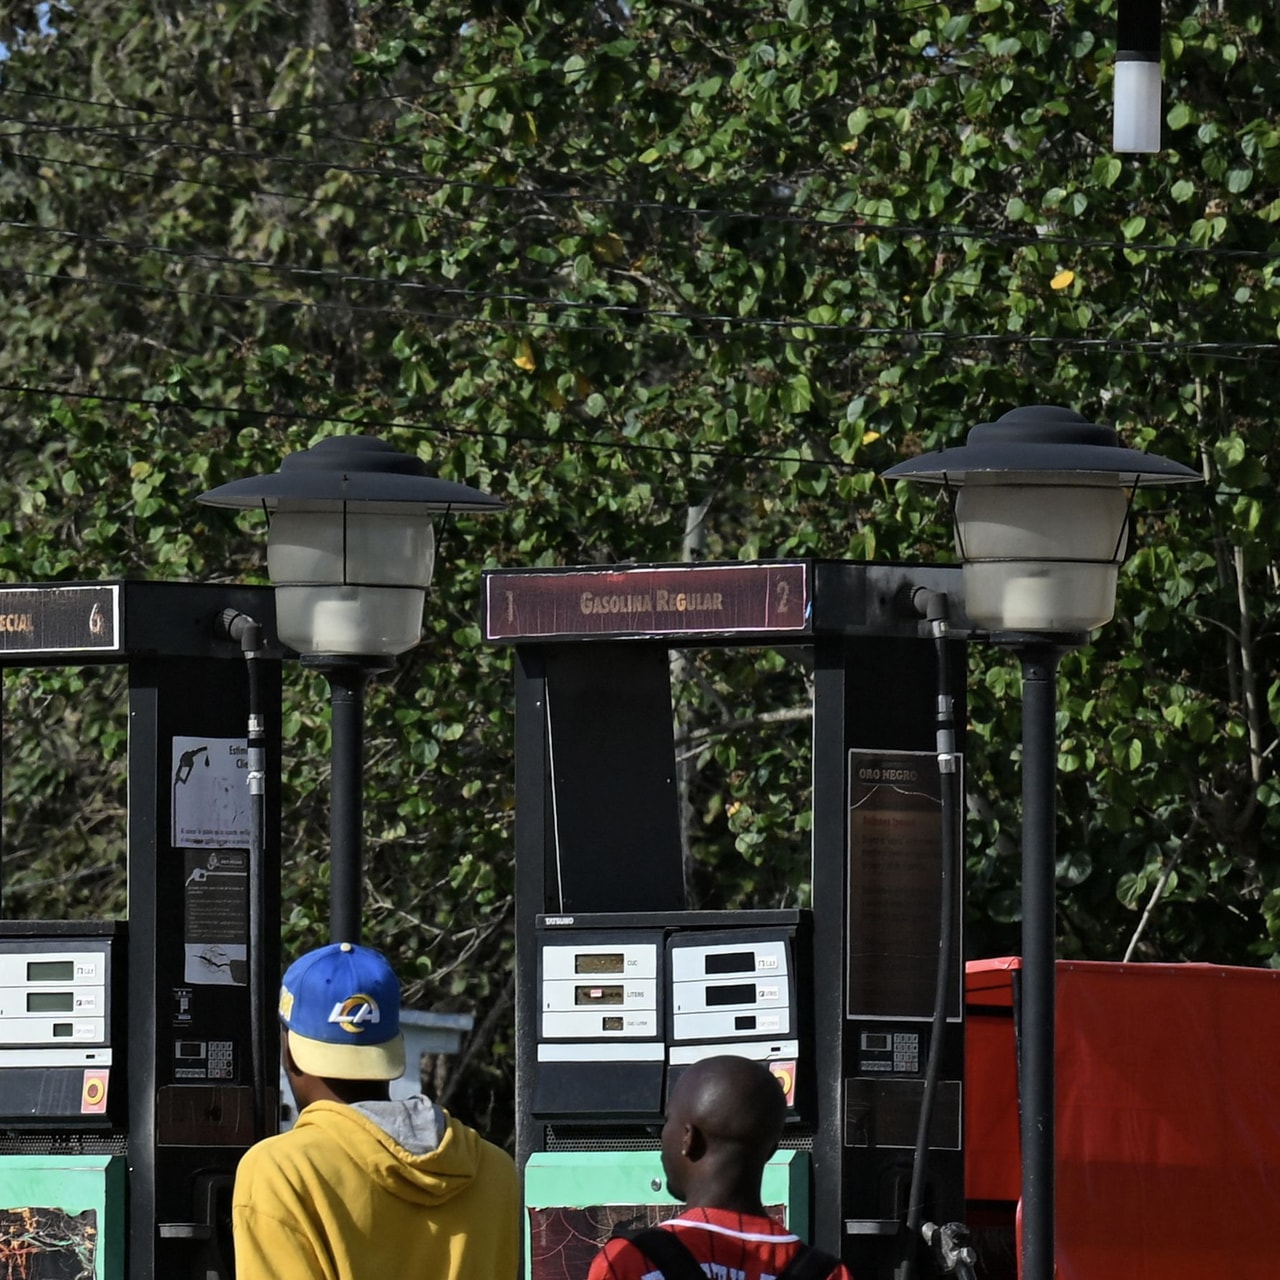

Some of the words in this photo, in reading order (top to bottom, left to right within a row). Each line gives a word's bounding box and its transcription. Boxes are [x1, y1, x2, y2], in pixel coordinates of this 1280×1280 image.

[580, 591, 653, 615] GASOLINA
[656, 588, 724, 613] REGULAR
[776, 580, 790, 614] 2
[89, 602, 105, 634] 6
[229, 745, 249, 756] Estim
[858, 768, 880, 780] ORO
[882, 769, 918, 782] NEGRO
[328, 1002, 380, 1024] LA
